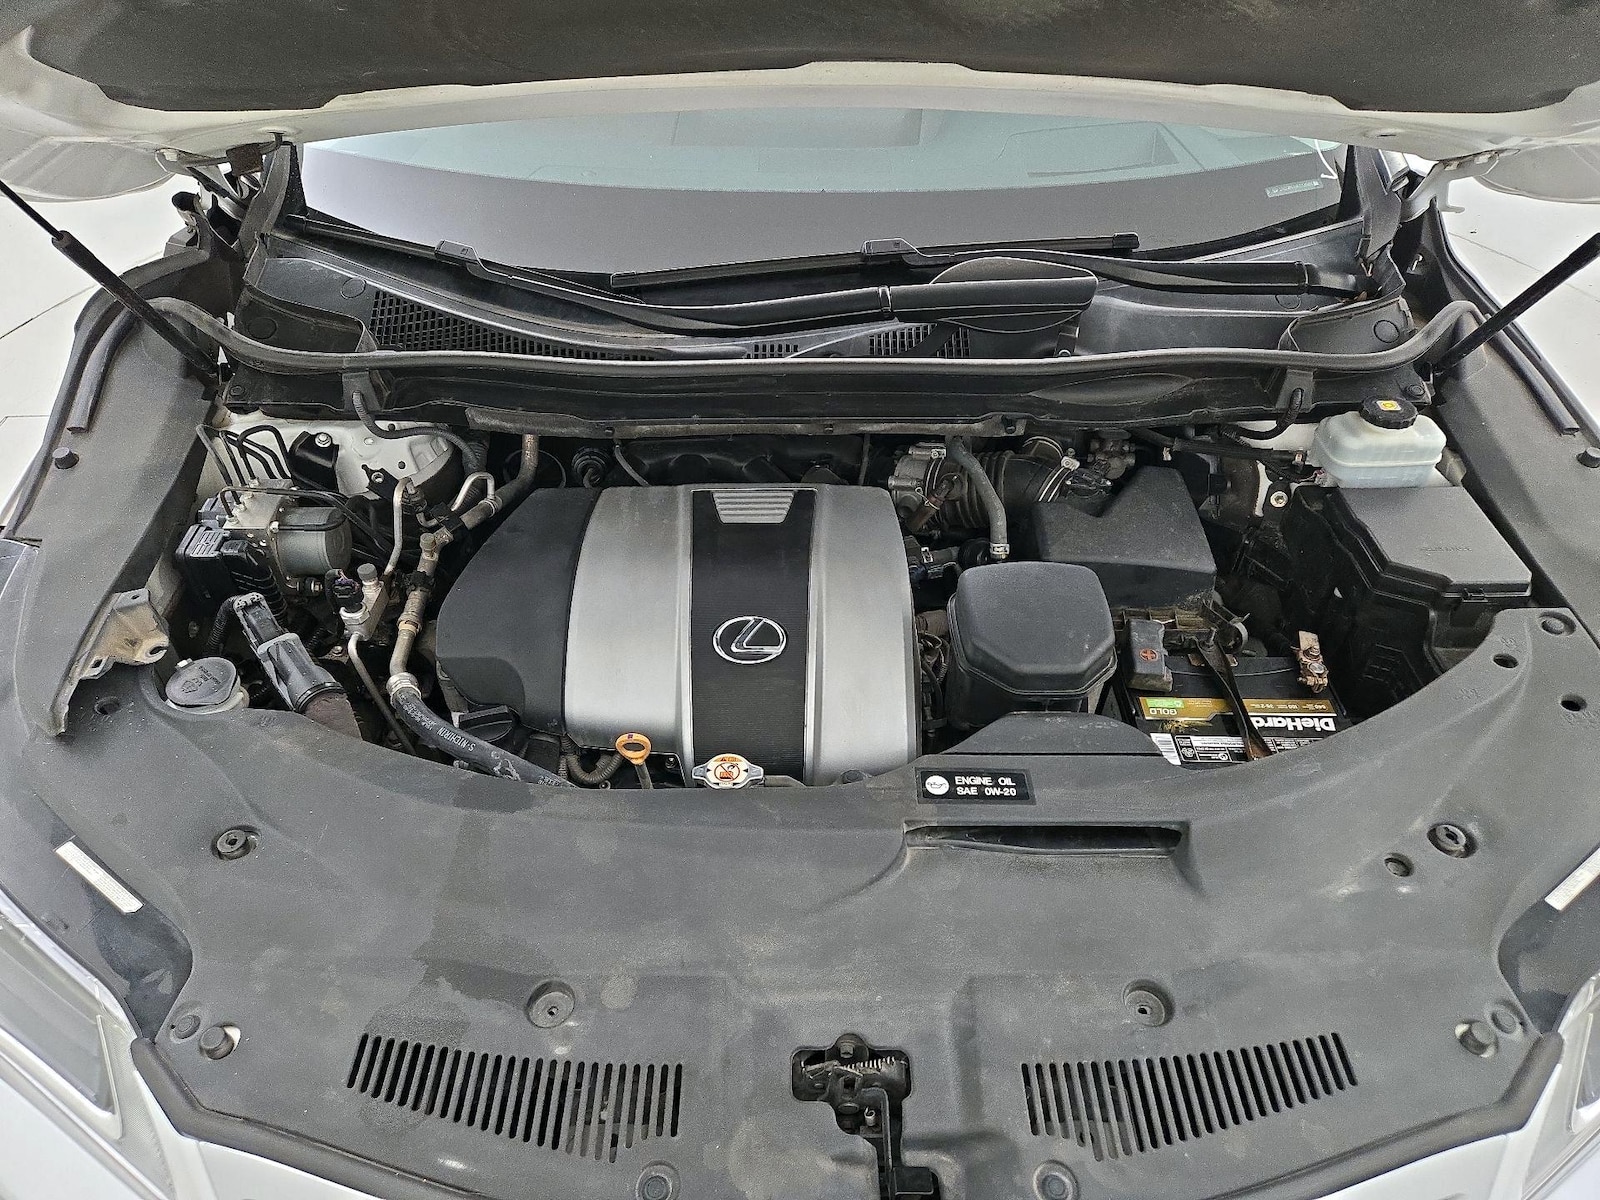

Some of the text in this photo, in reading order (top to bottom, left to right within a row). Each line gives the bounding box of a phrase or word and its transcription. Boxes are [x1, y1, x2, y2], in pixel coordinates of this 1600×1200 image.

[1149, 708, 1177, 716] GOLD
[1250, 716, 1336, 732] DieHard
[954, 776, 1016, 786] ENGINE OIL
[956, 787, 1017, 796] SAE 0W-20
